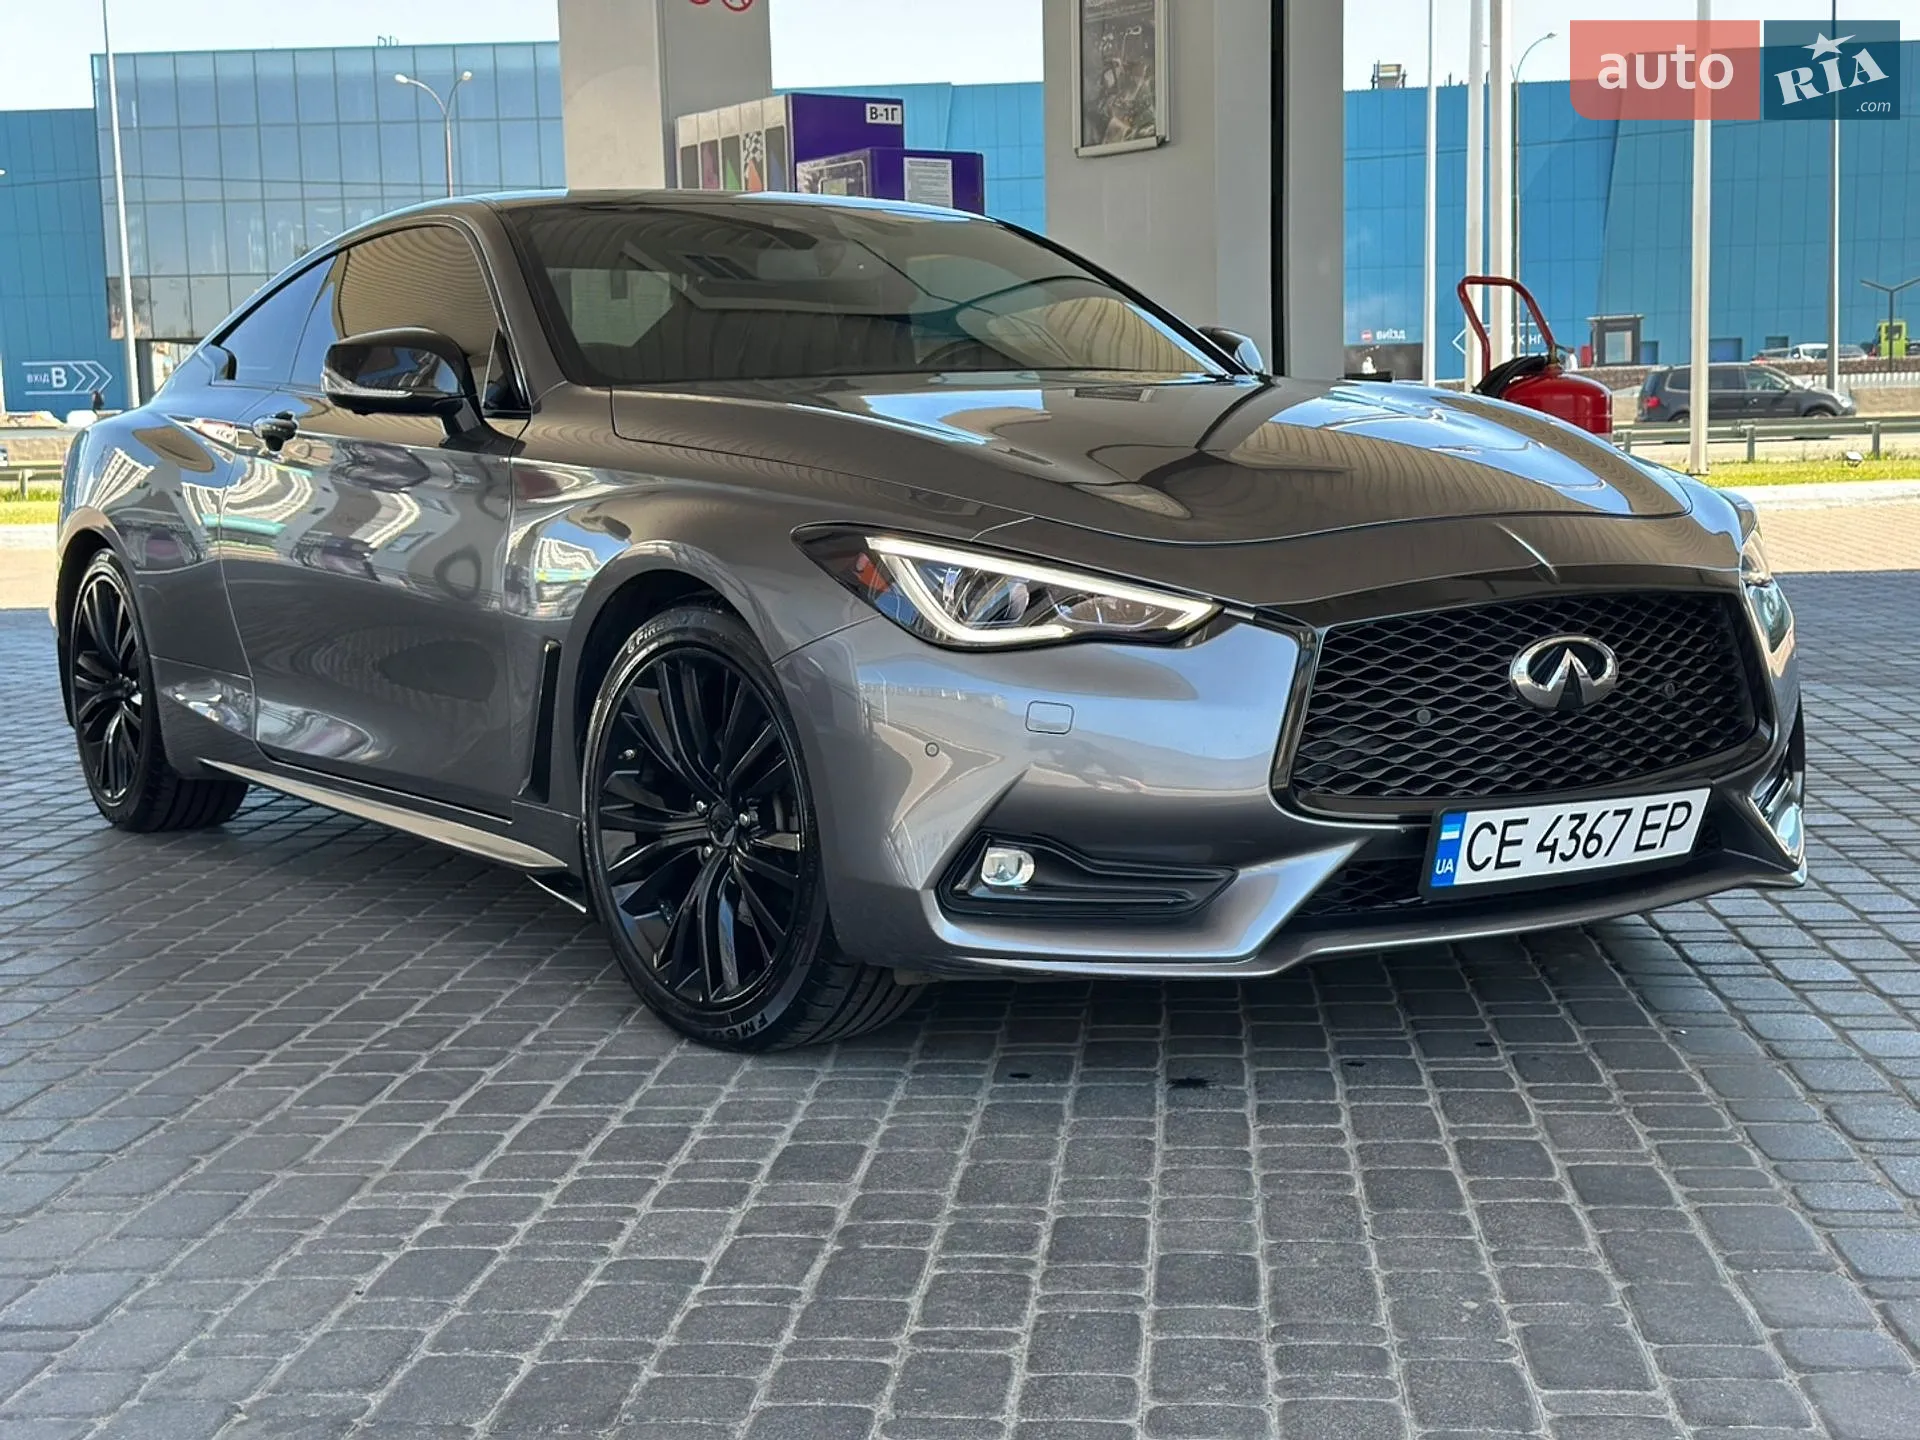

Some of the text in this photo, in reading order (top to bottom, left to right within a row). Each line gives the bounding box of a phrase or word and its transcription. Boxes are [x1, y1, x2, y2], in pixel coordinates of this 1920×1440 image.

[1466, 800, 1693, 872] CE 4367 EP
[1435, 857, 1454, 876] UA
